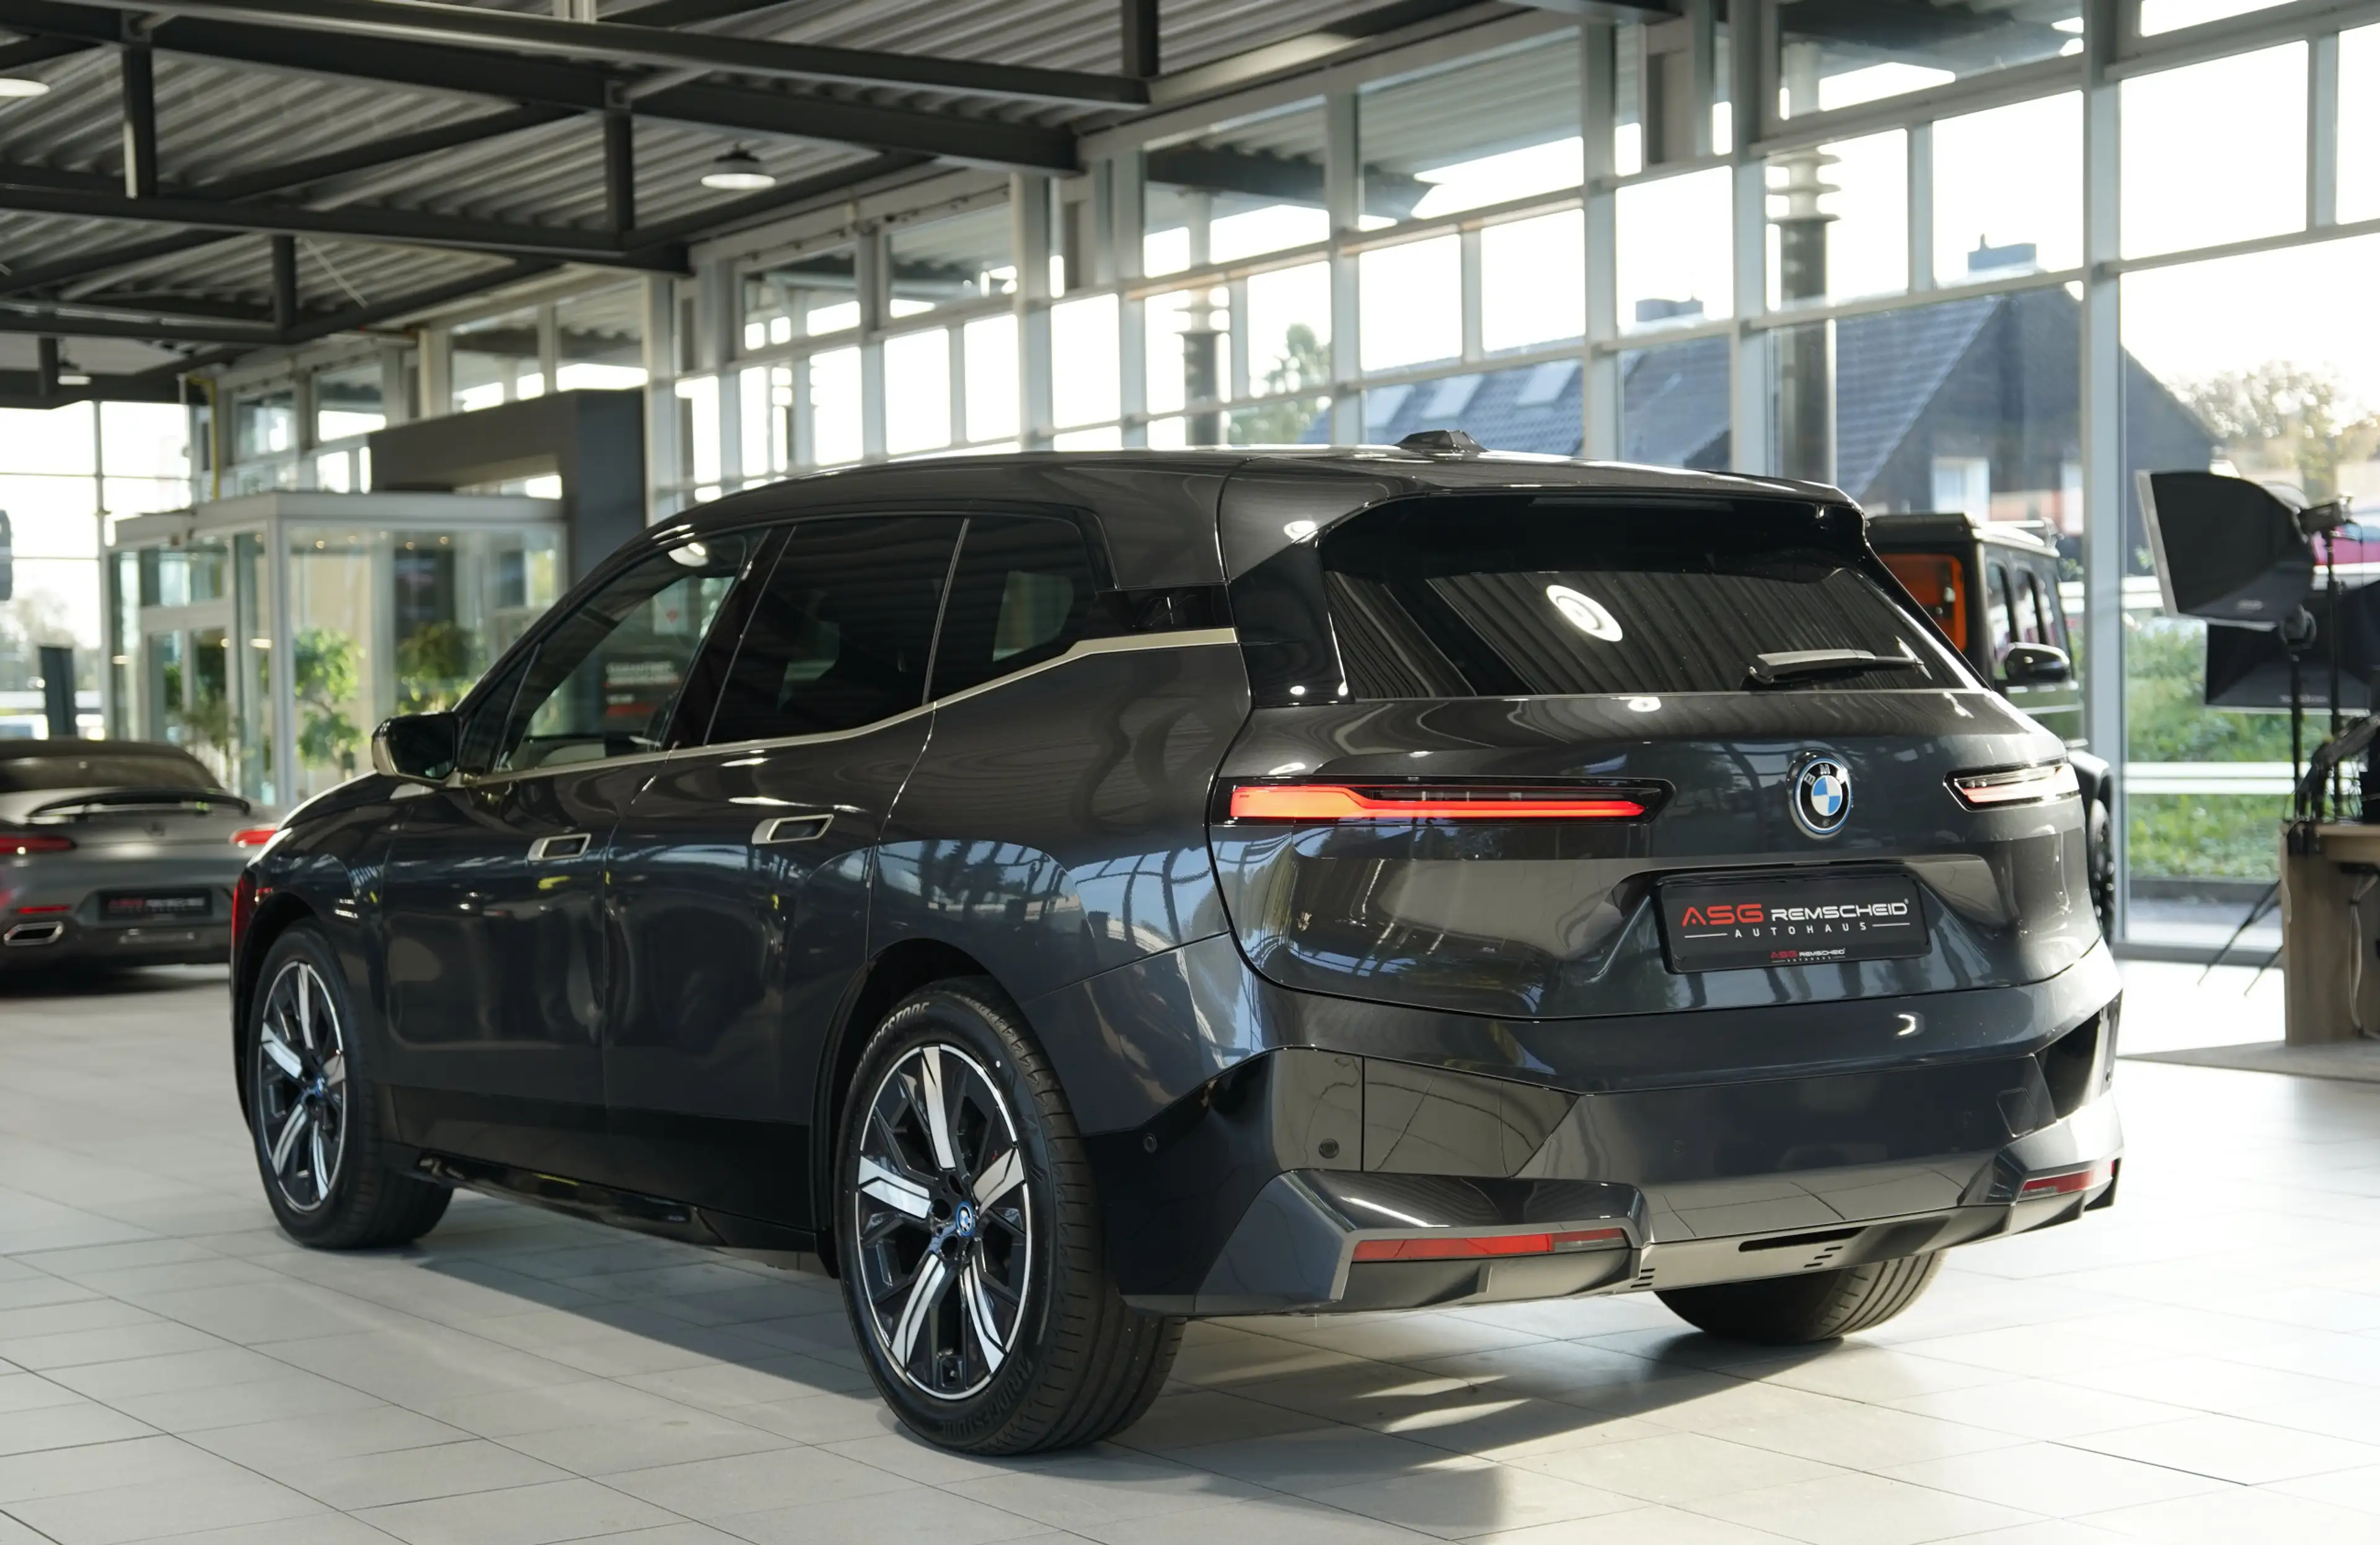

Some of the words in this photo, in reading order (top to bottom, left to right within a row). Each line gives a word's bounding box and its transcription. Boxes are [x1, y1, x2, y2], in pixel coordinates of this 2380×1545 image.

[1682, 904, 1764, 927] ASG
[1735, 922, 1867, 938] AUTOHAUS
[1771, 950, 1797, 958] ASG
